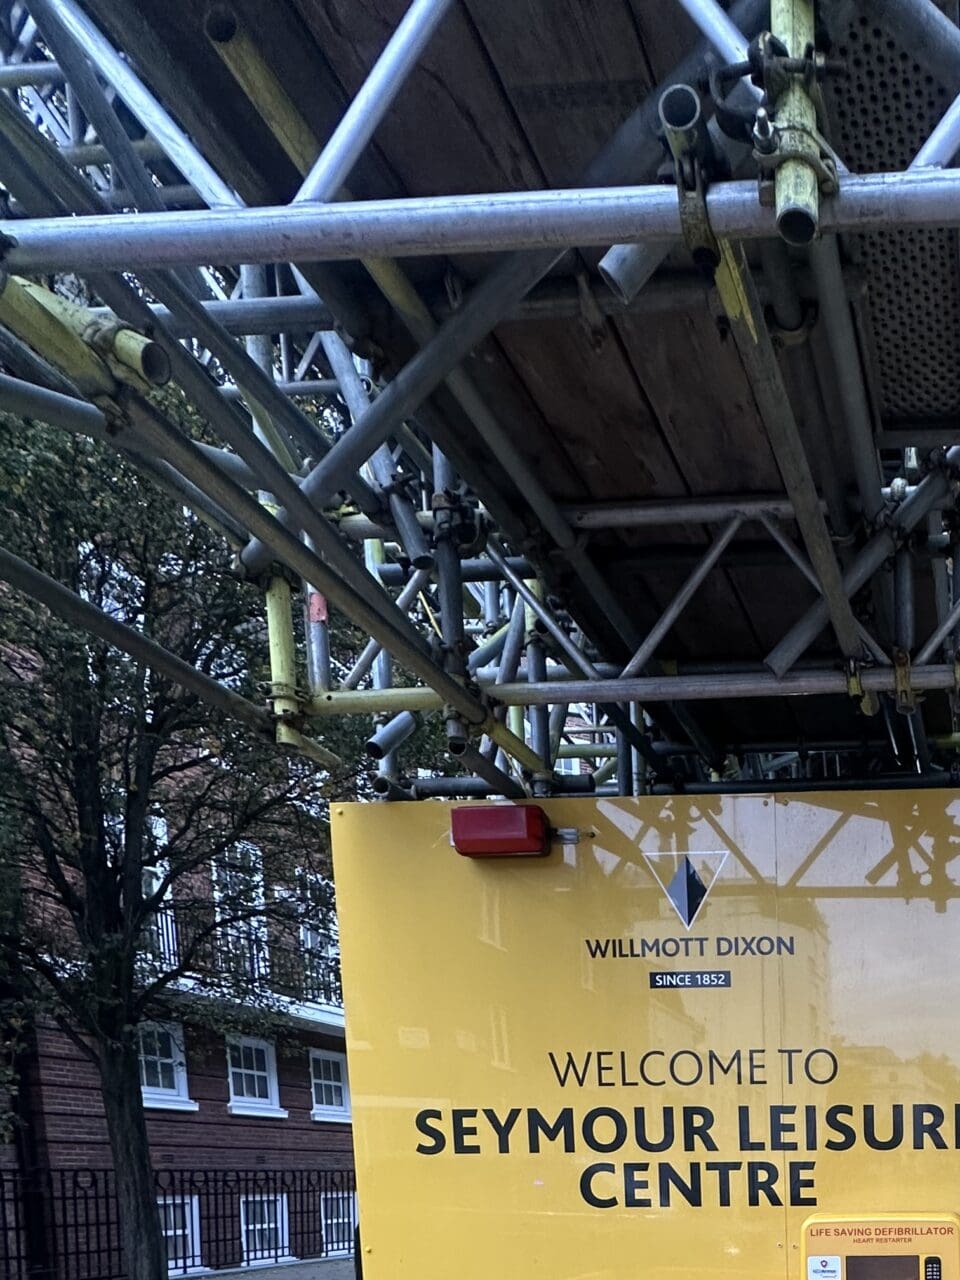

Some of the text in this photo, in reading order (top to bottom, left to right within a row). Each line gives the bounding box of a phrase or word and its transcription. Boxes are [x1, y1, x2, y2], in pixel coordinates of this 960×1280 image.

[586, 936, 795, 958] WILLMOTT DIXON
[655, 973, 725, 986] SINCE 1852
[549, 1049, 838, 1088] WELCOME TO
[415, 1106, 719, 1155] SEYMOUR
[579, 1162, 818, 1209] CENTRE
[810, 1227, 954, 1237] LIFE SAVING DEFIBRILLATOR
